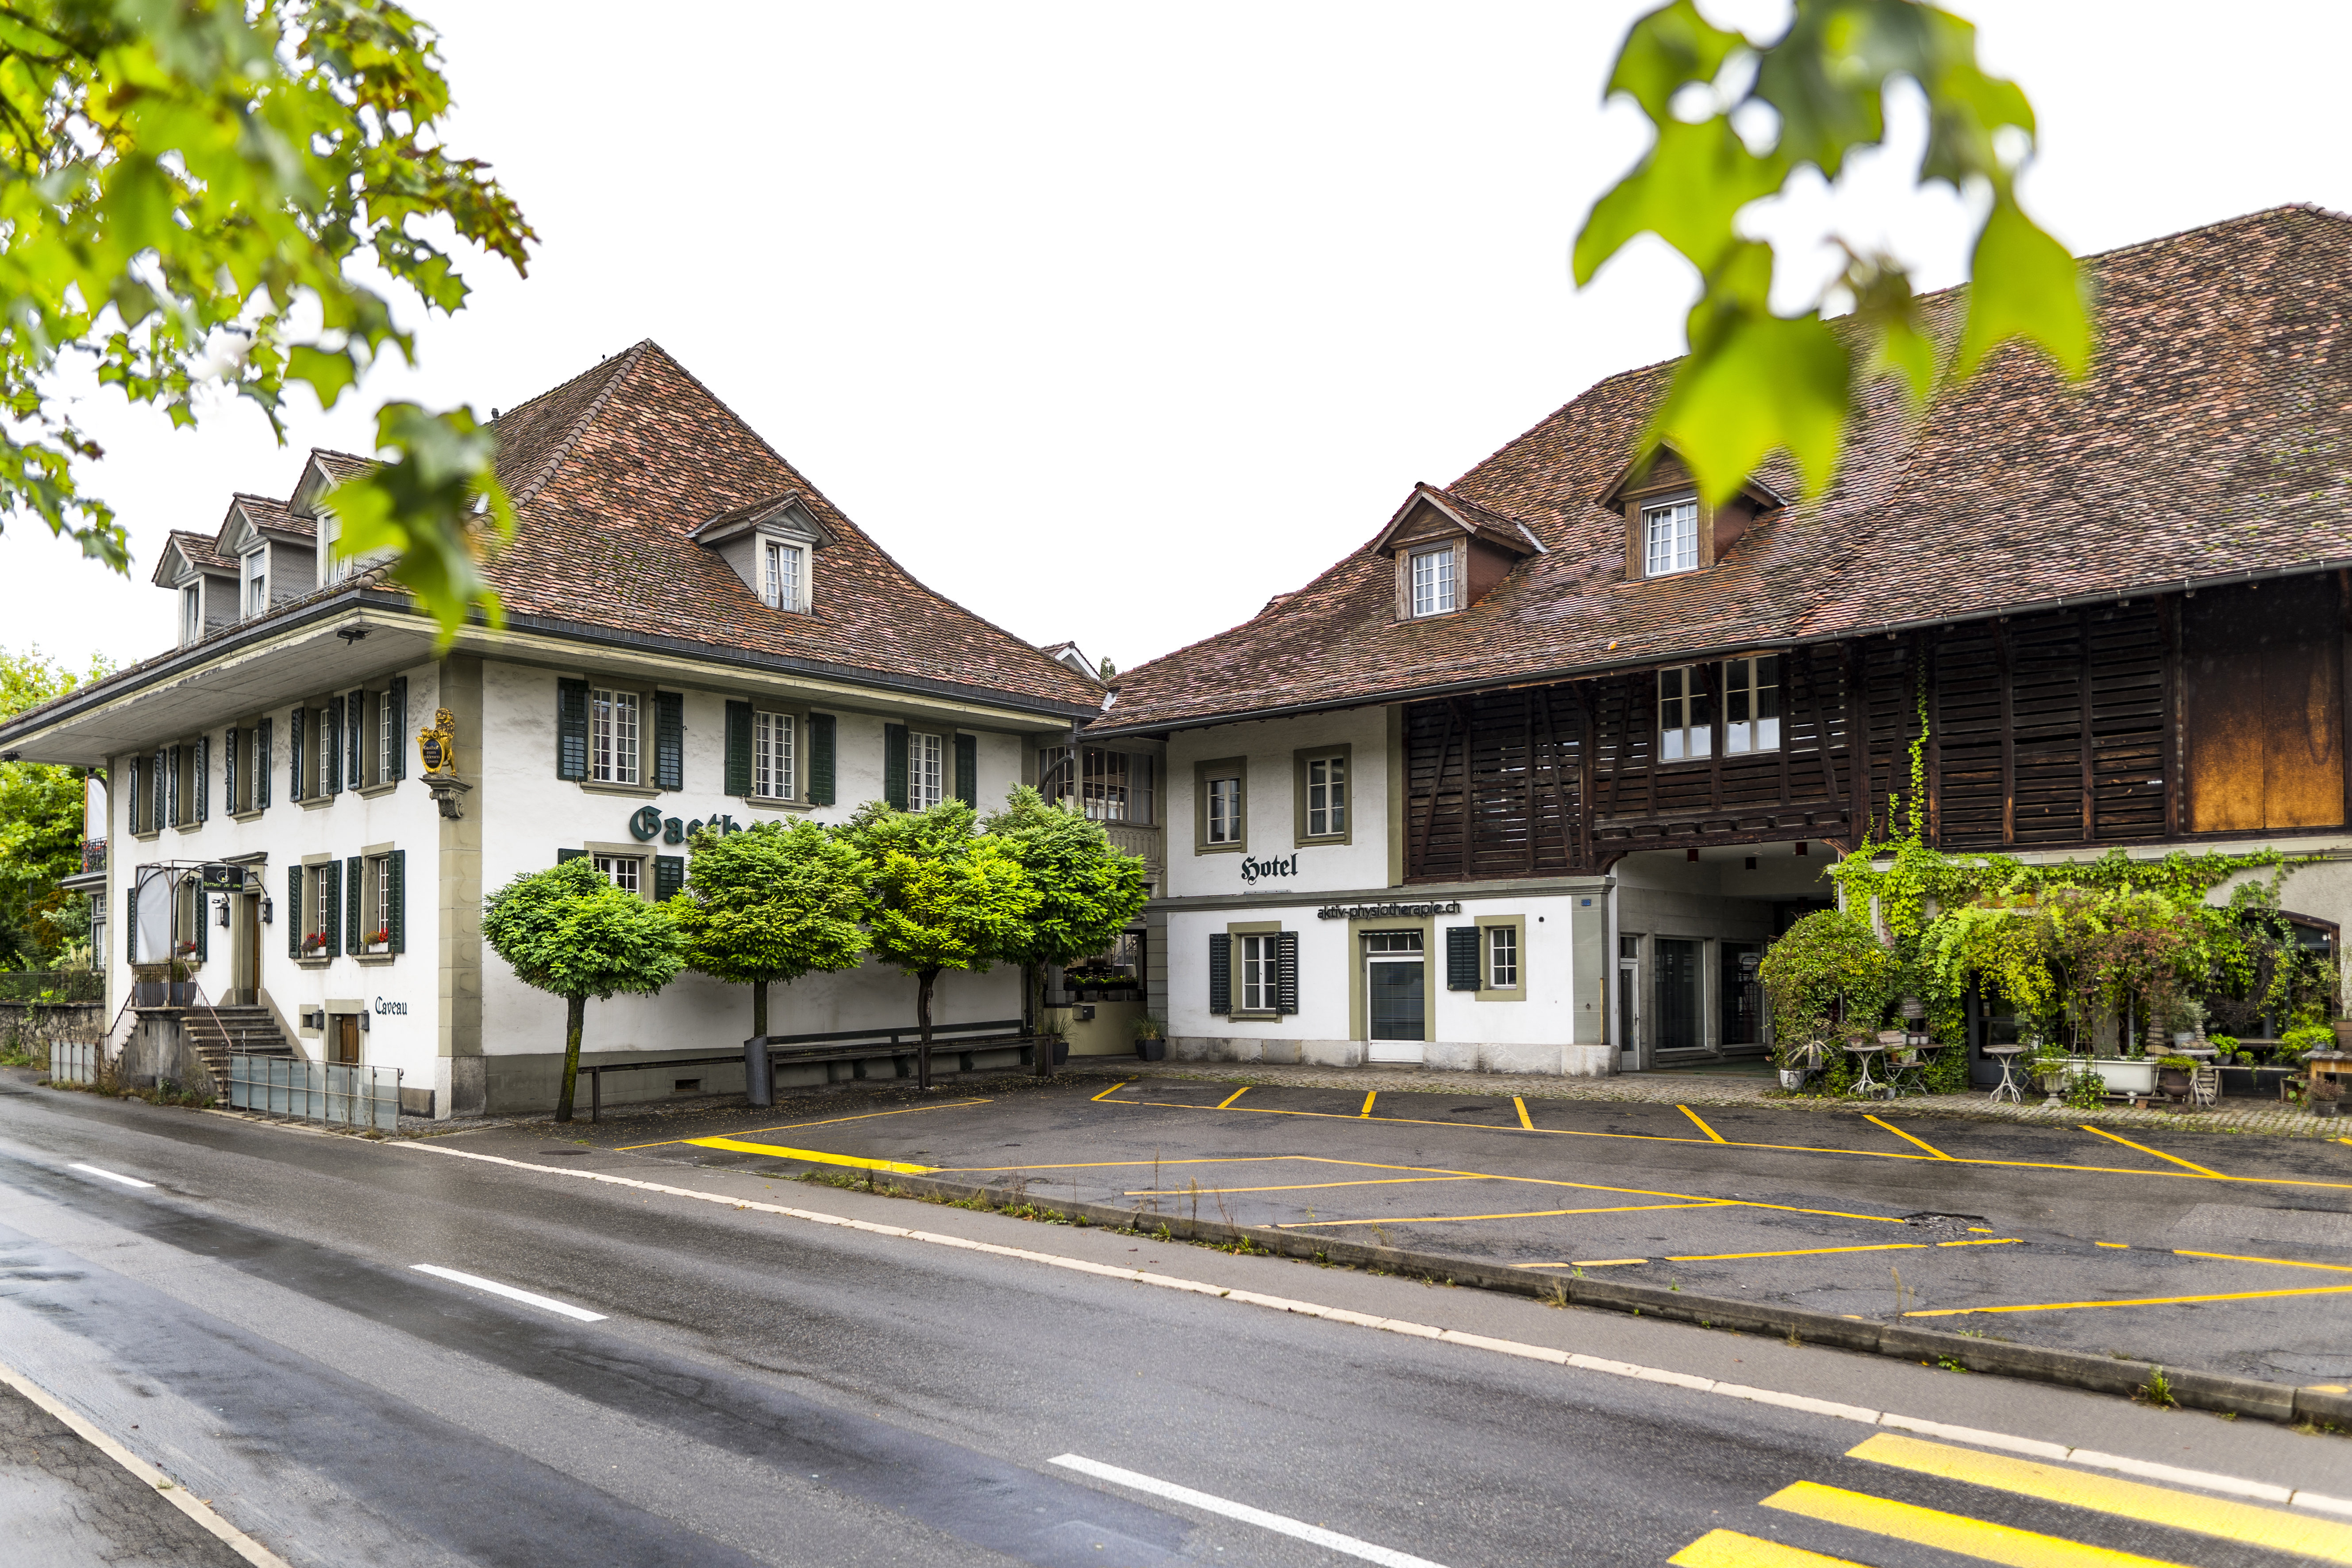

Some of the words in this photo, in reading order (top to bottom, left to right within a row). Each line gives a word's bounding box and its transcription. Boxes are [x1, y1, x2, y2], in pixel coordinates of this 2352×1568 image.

[1241, 852, 1299, 886] Hotel
[1317, 900, 1462, 920] aktiv-physiotherapie.ch
[375, 996, 408, 1016] Caveau
